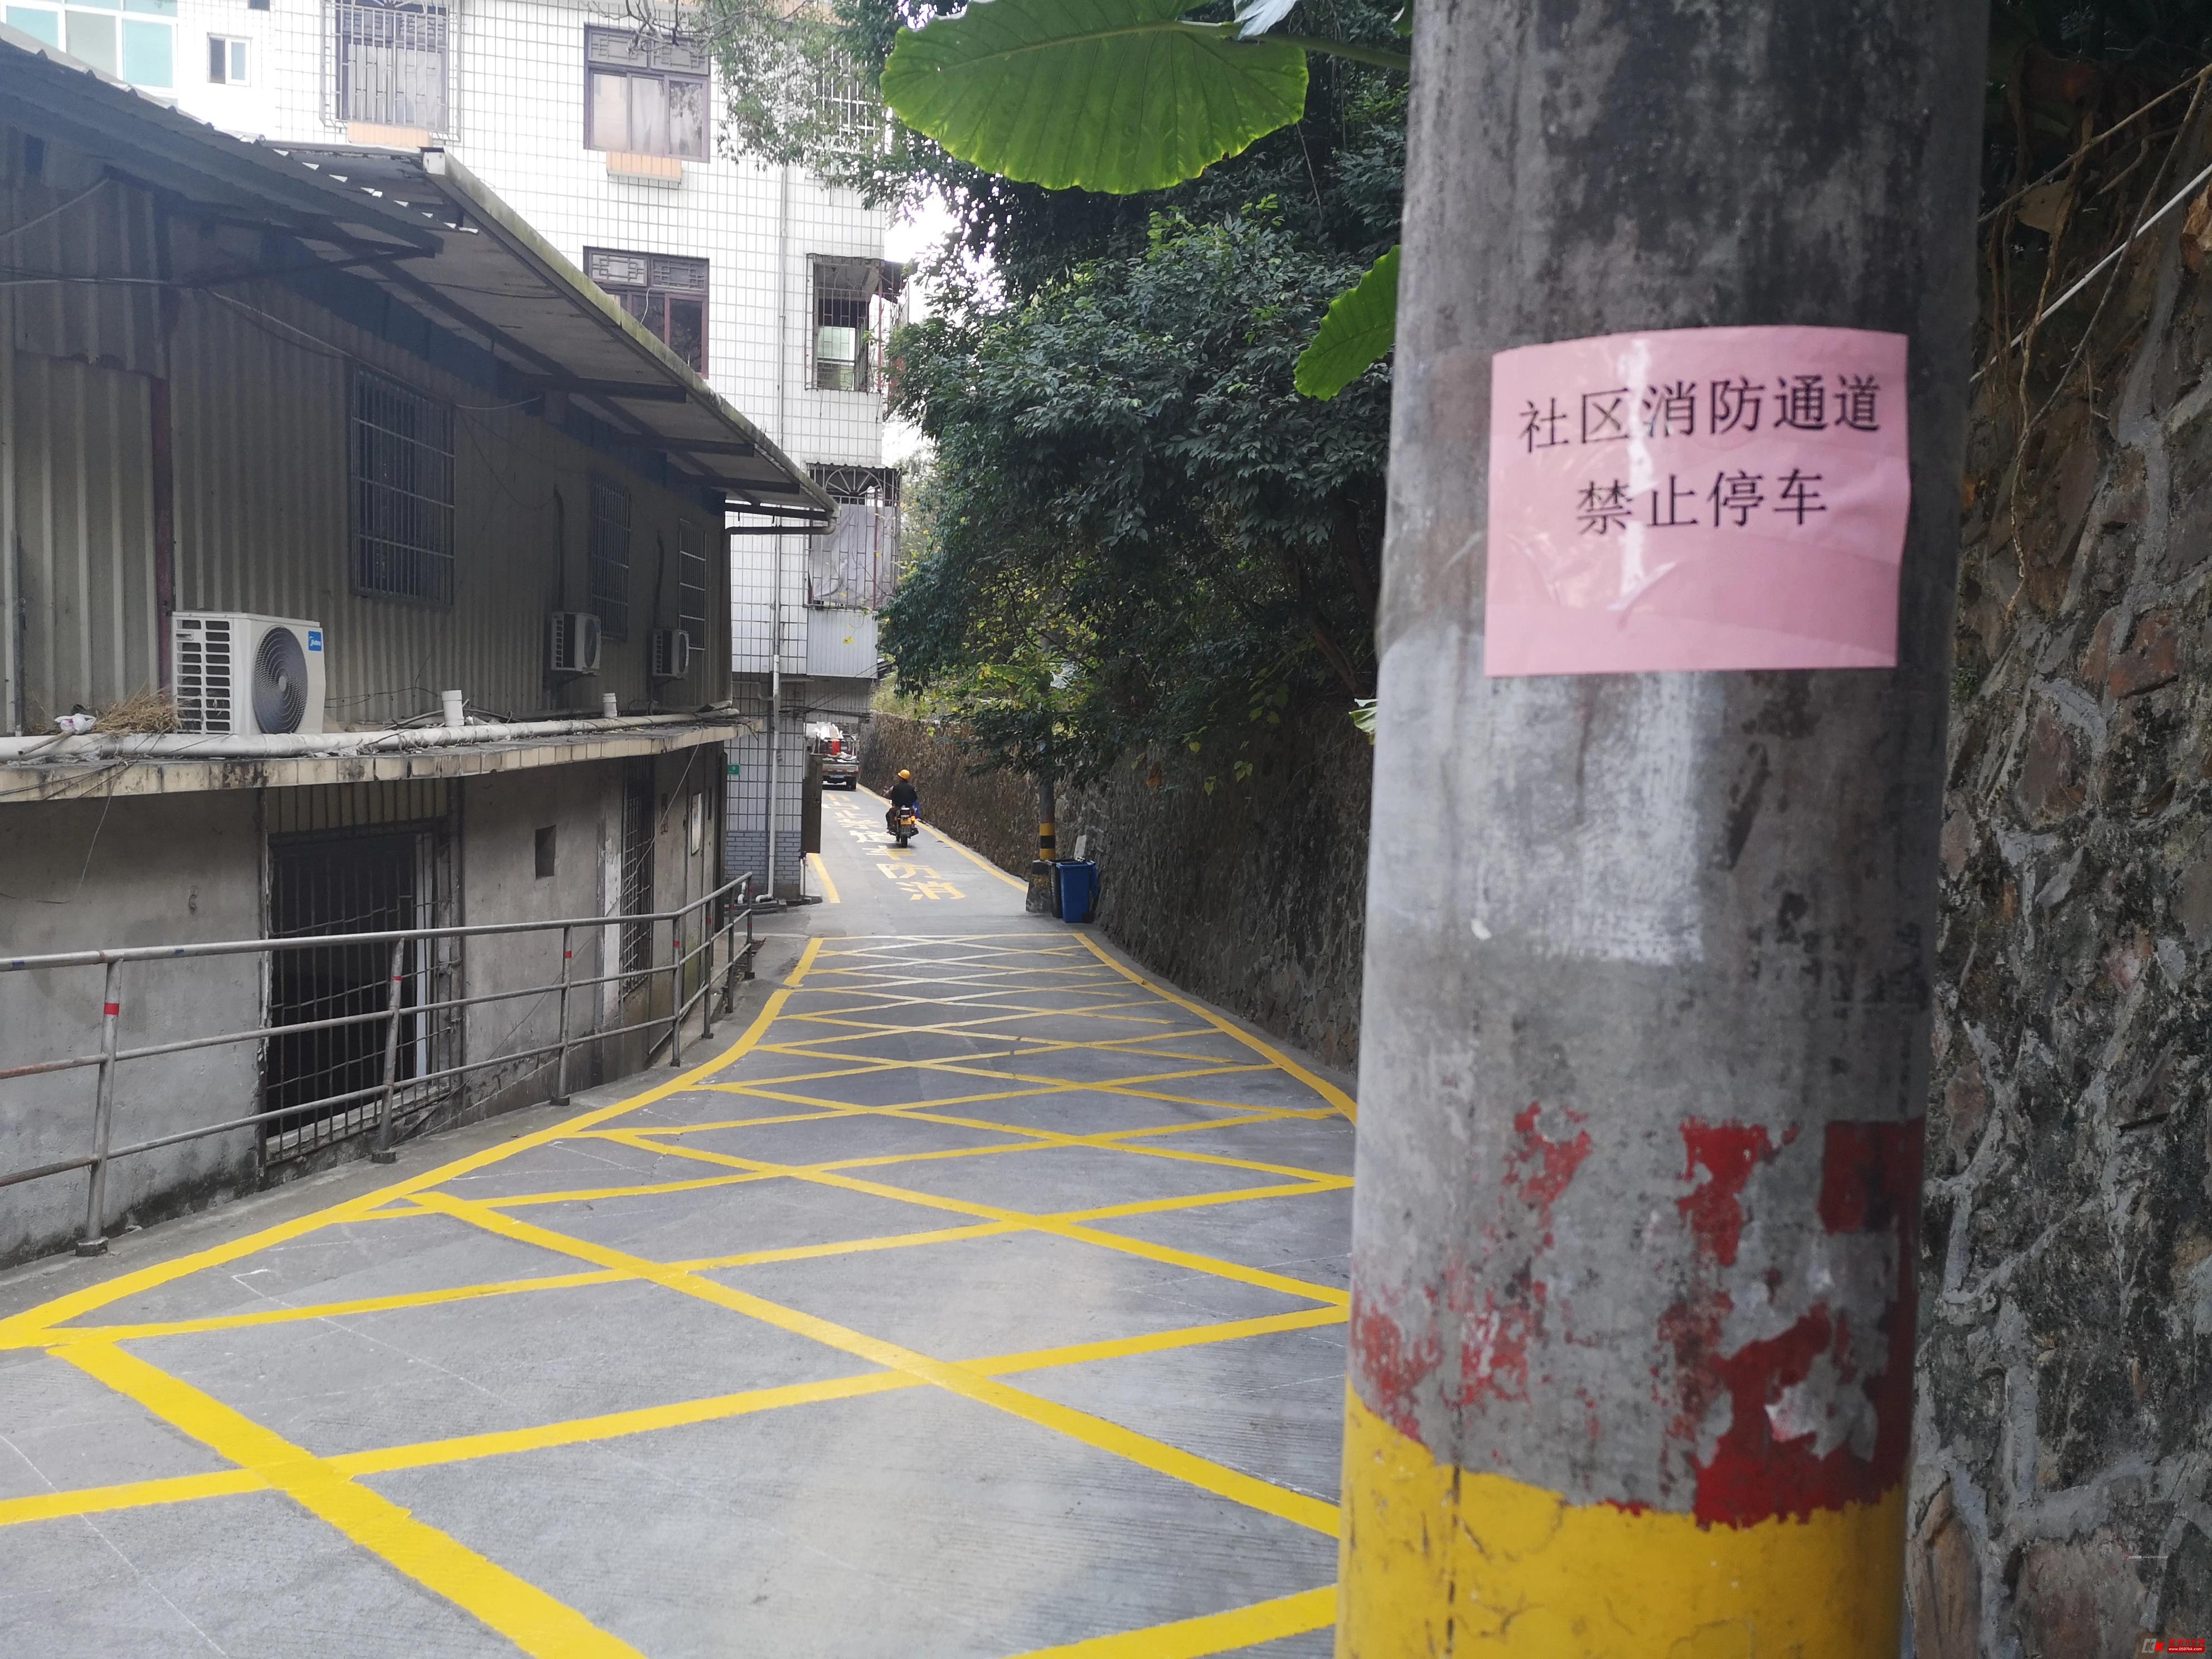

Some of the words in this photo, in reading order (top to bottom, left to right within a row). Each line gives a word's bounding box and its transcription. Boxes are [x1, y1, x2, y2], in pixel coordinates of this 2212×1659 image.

[1519, 375, 1881, 453] 社区消防通道
[1576, 468, 1827, 536] 禁止停车
